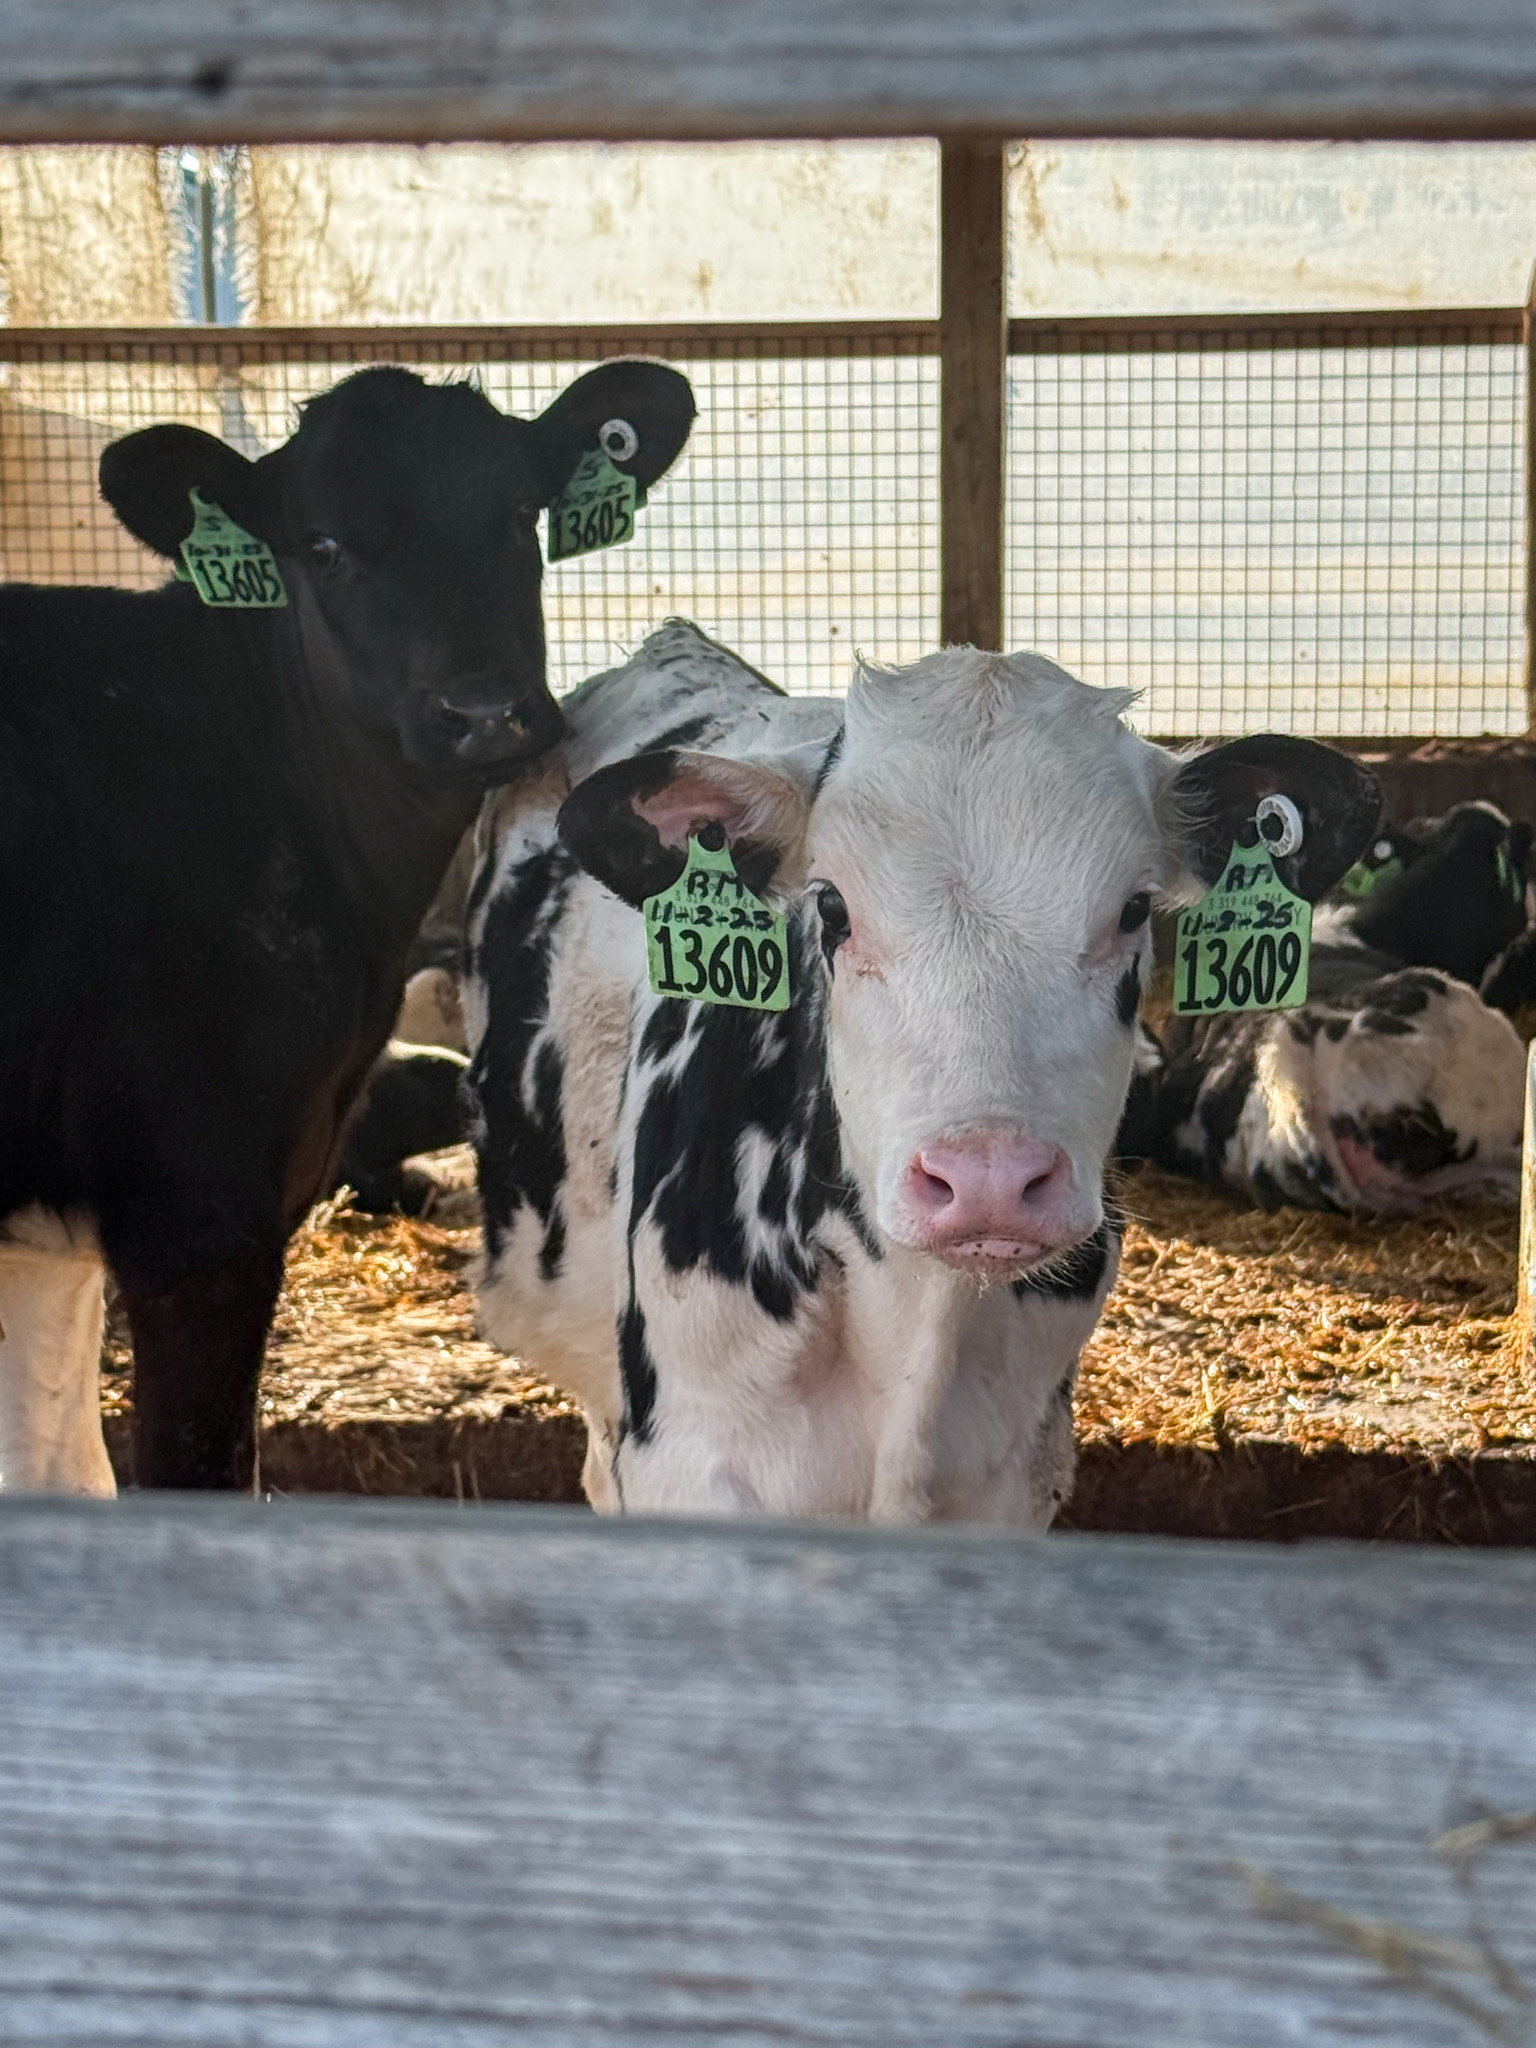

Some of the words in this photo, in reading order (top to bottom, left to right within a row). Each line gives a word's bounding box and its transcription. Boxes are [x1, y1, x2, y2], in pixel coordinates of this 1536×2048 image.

[553, 494, 630, 555] 13605
[196, 559, 280, 603] 13605
[653, 926, 783, 1003] 13609
[1178, 931, 1301, 1011] 13609
